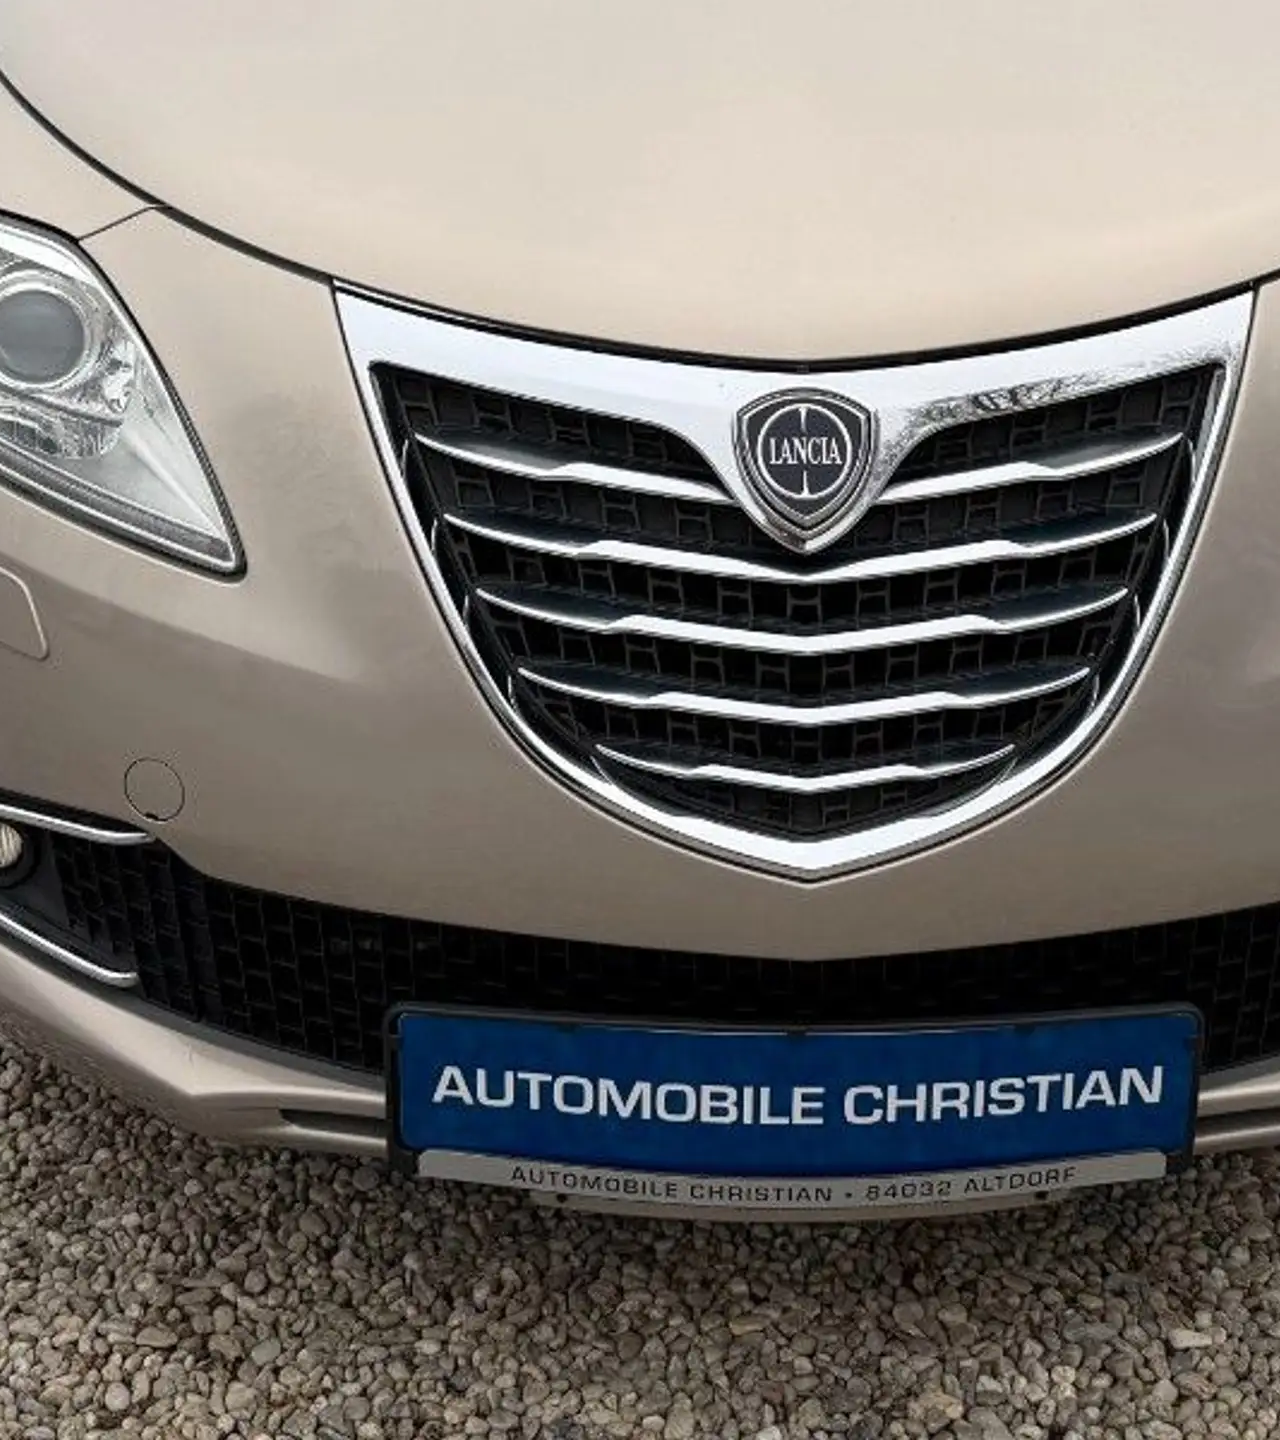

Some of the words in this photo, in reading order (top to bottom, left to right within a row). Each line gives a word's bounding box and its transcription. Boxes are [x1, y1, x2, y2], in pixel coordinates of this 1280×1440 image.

[769, 436, 843, 465] LANCIA
[432, 1065, 826, 1126] AUTOMOBILE
[843, 1065, 1164, 1126] CHRISTIAN
[510, 1166, 678, 1199] AUTOMOBILE
[690, 1184, 832, 1203] CHRISTIAN
[865, 1180, 952, 1202] 84032
[963, 1166, 1077, 1194] ALTDORF
